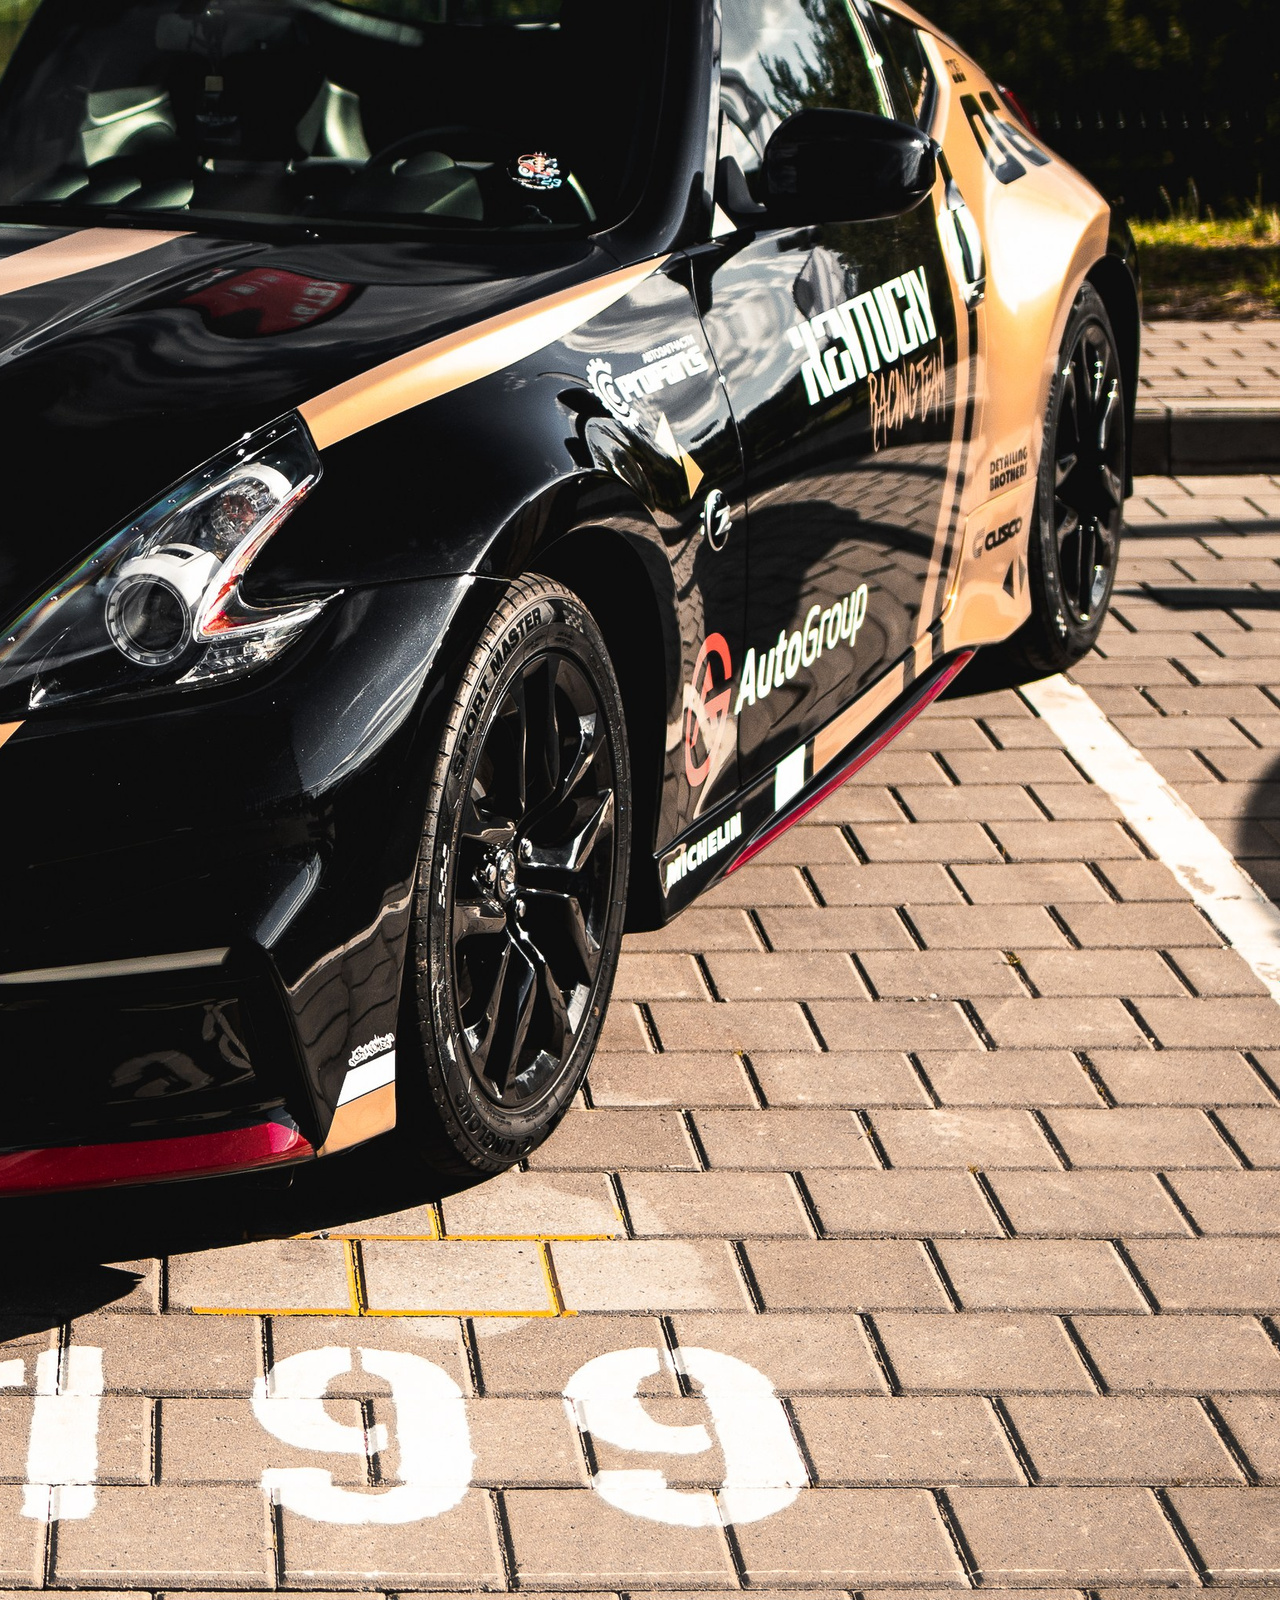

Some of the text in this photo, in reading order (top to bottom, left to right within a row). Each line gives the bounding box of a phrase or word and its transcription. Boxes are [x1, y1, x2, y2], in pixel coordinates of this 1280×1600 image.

[787, 265, 937, 406] KENTUCKY
[868, 362, 918, 453] RACING
[914, 336, 946, 424] TEAM
[989, 446, 1028, 475] DETAILING
[989, 462, 1028, 492] BROTHERS
[449, 607, 542, 780] SPORT MASTER
[734, 583, 869, 715] AutoGroup
[665, 811, 743, 889] MICHELIN
